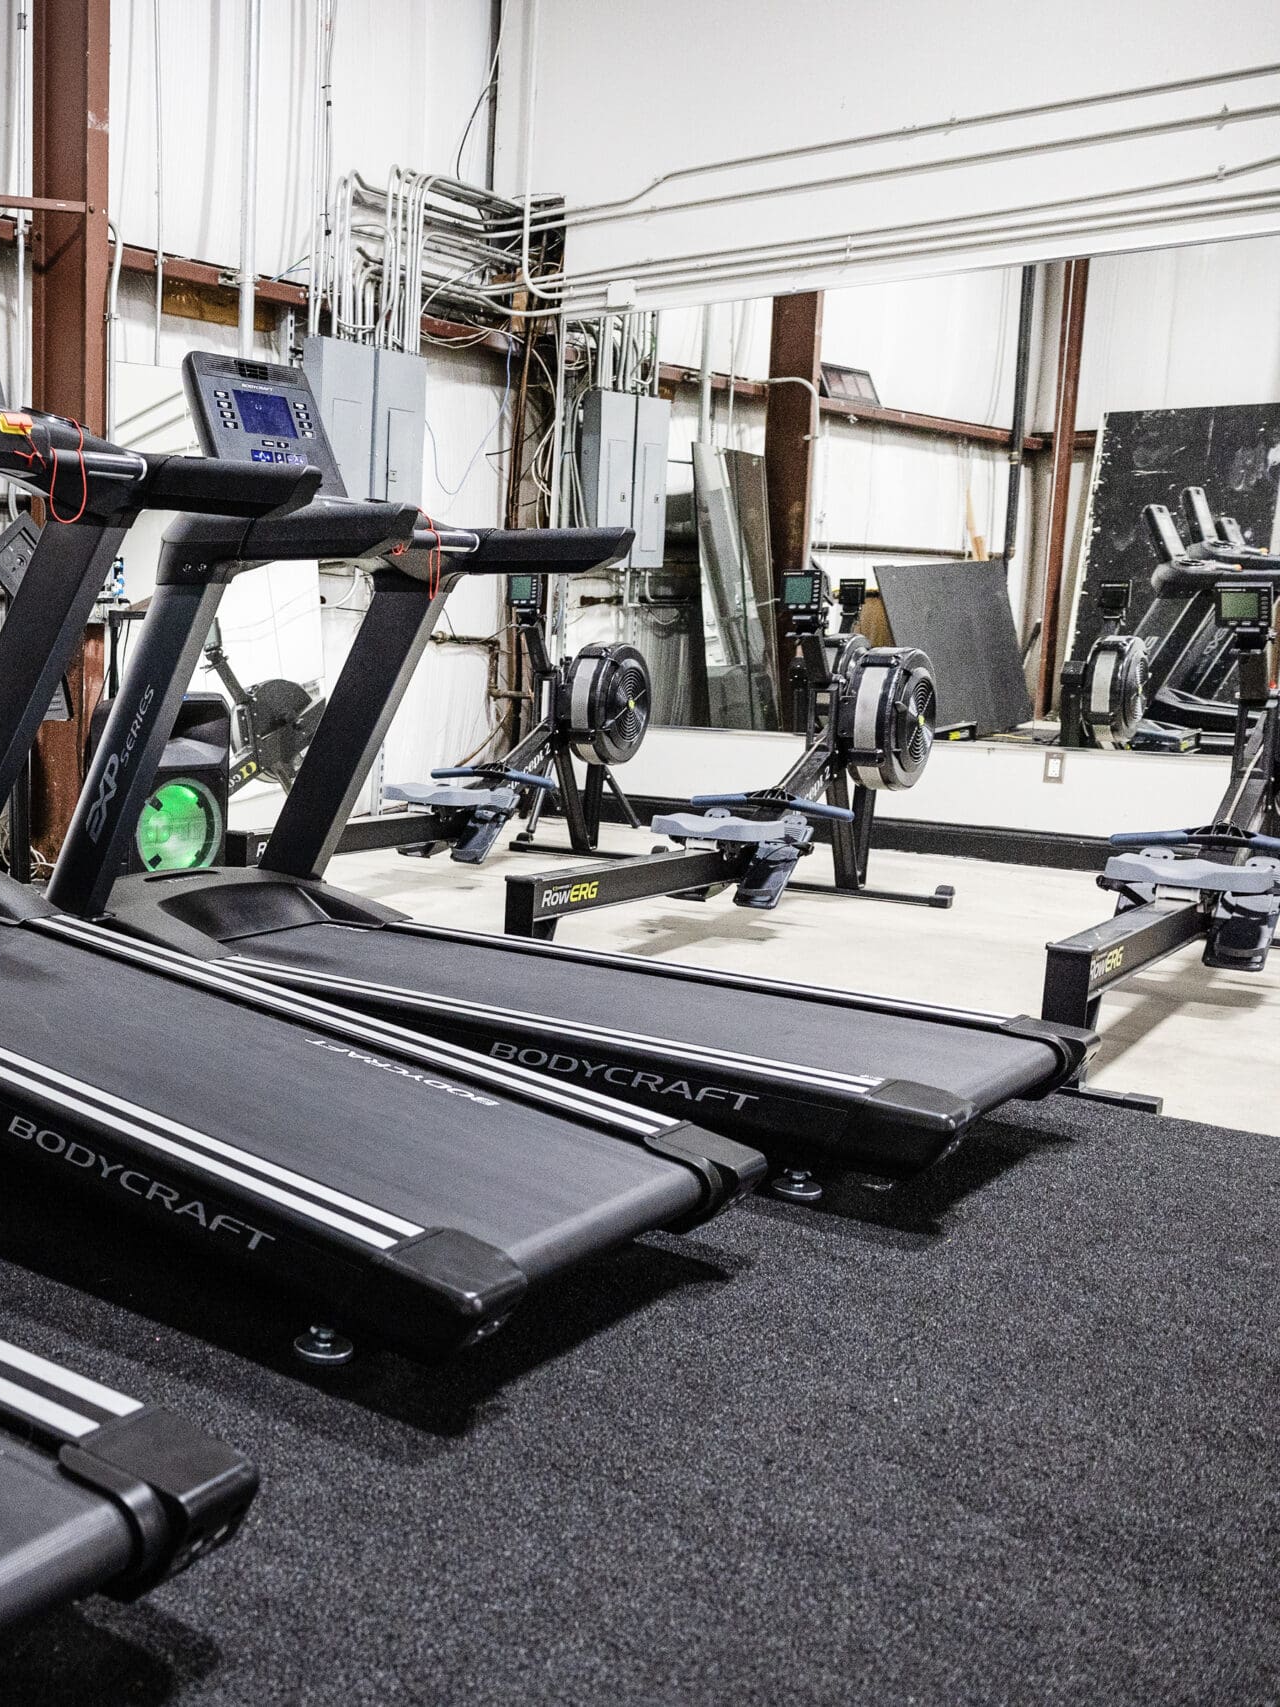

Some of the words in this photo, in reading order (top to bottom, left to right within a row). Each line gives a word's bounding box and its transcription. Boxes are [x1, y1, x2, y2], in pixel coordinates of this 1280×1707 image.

[119, 683, 156, 768] SERIES
[544, 742, 552, 755] 2
[824, 765, 831, 781] 2
[304, 1038, 501, 1106] BODYCRAFT
[488, 1041, 761, 1111] BODYCRAFT
[7, 1115, 276, 1251] BODYCRAFT
